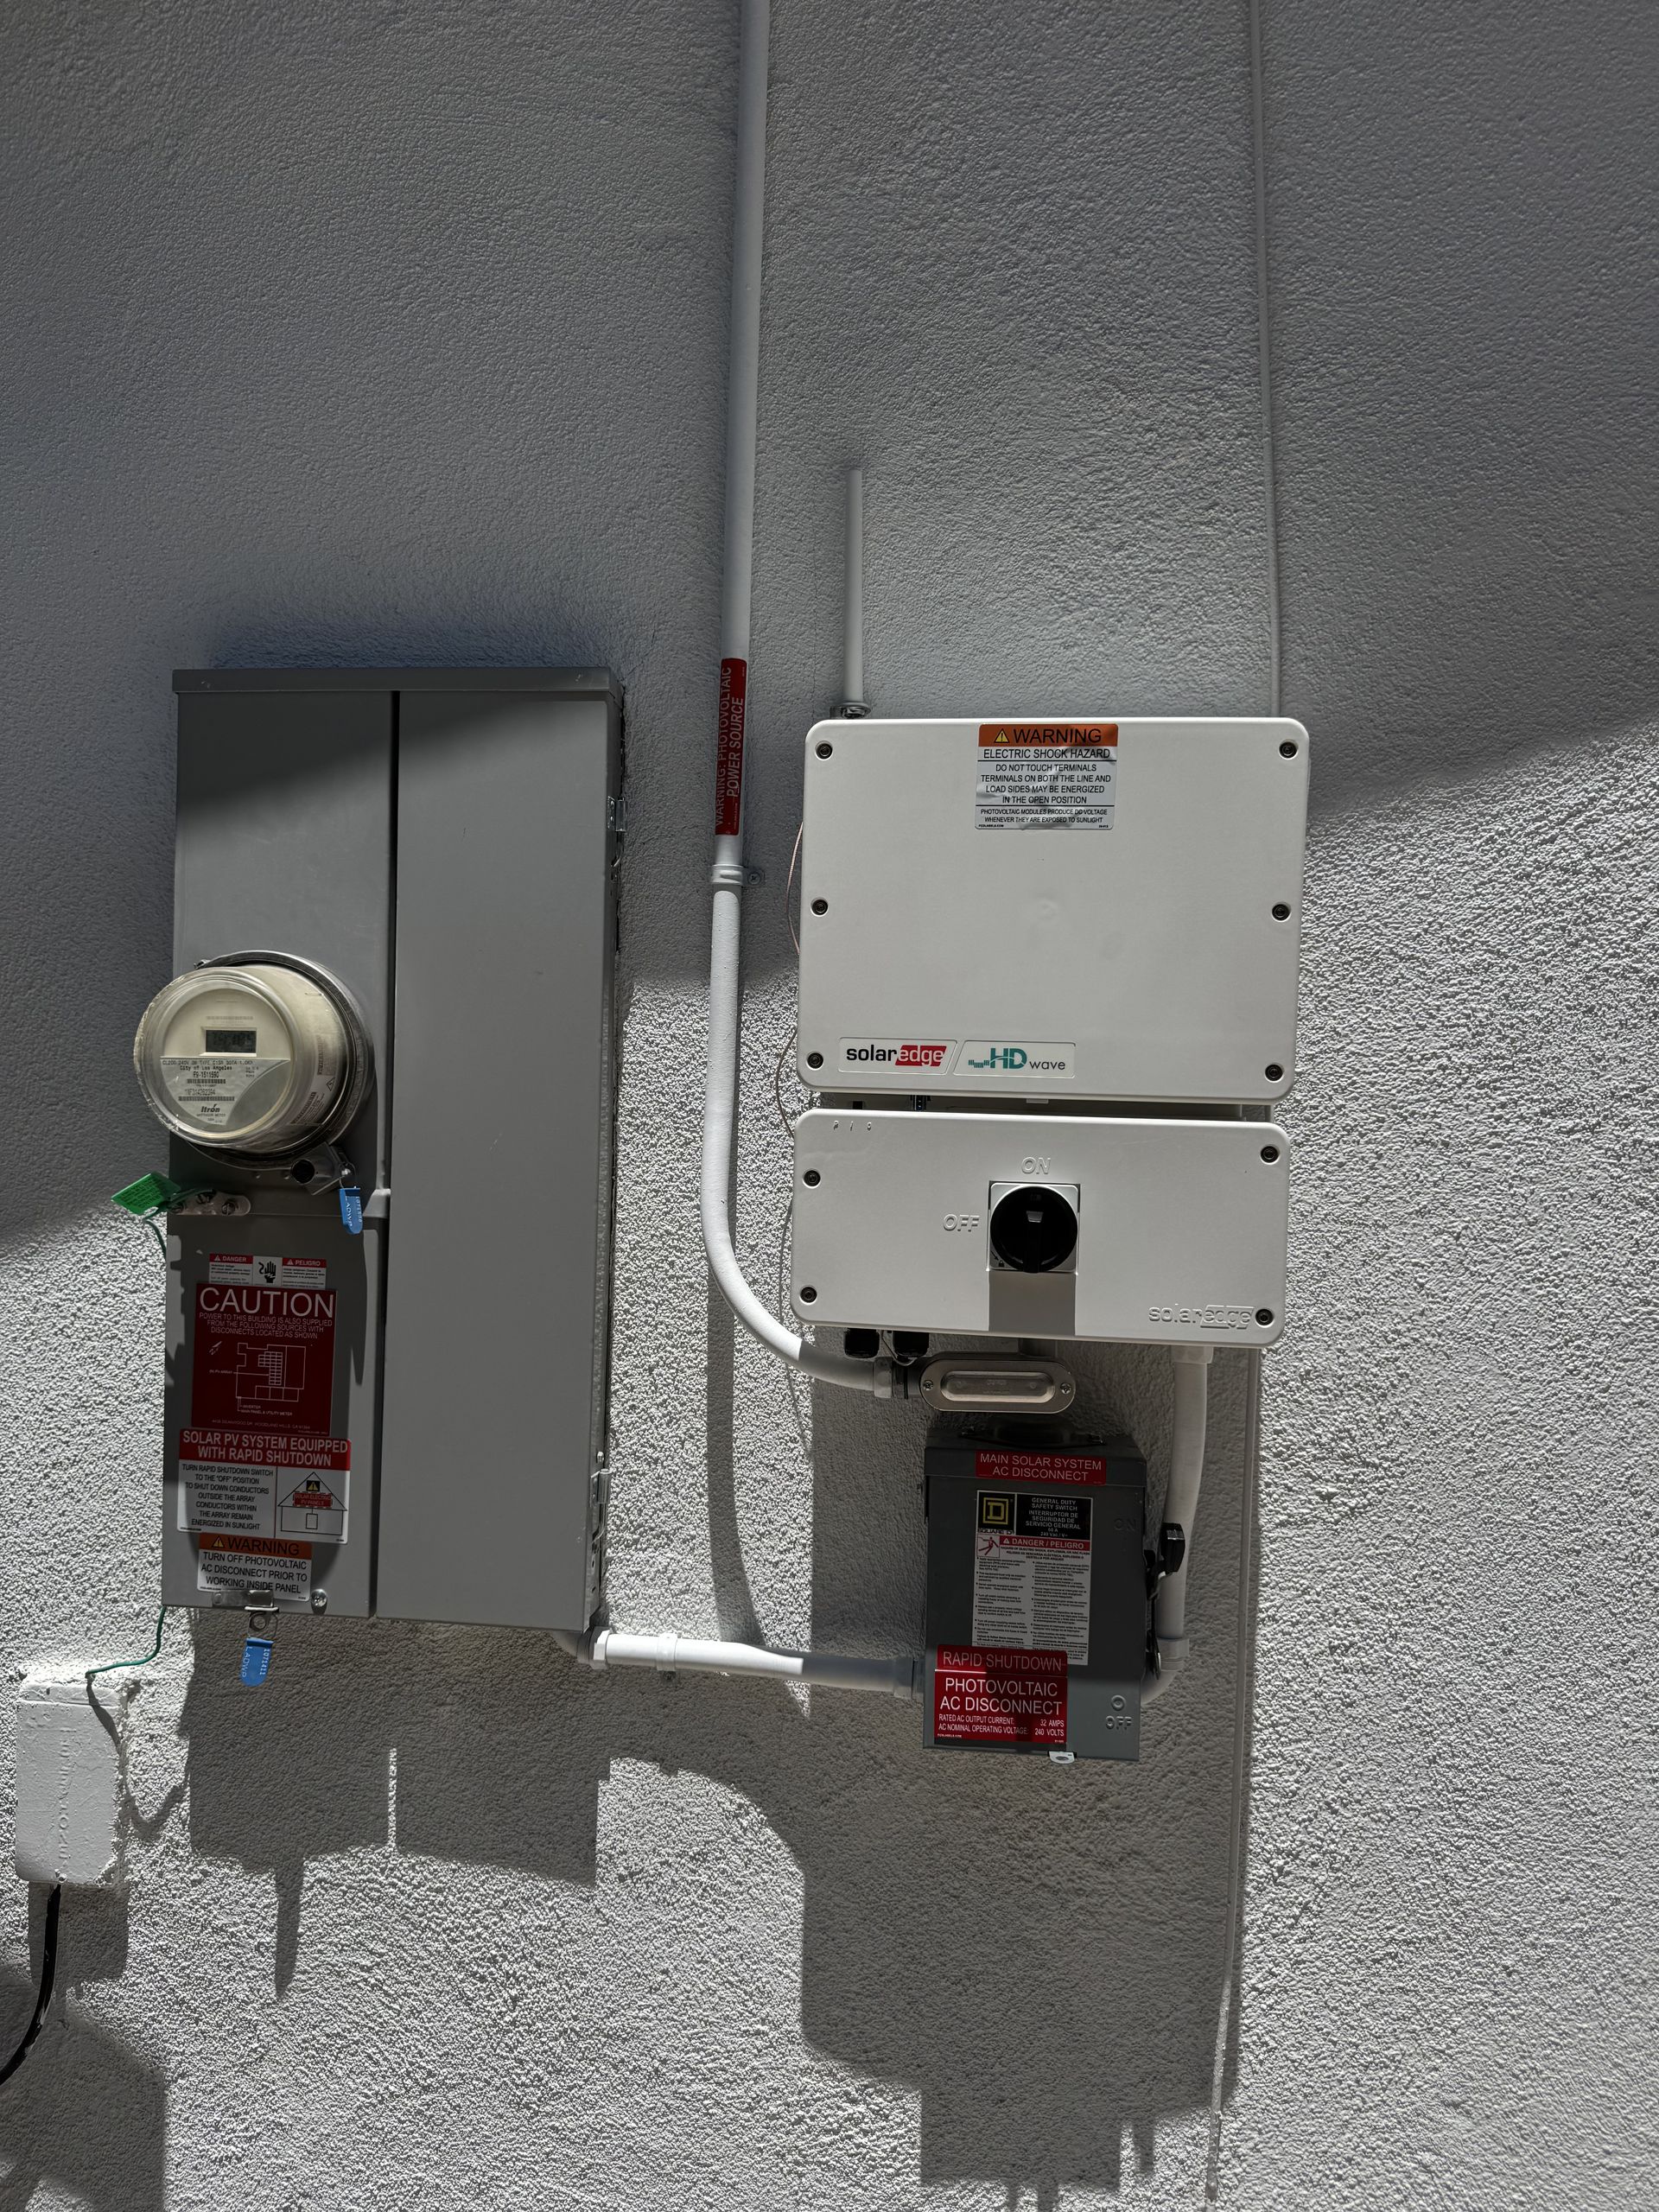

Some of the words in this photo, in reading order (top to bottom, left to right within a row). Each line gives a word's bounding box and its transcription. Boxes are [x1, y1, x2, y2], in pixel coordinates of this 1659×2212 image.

[719, 667, 732, 761] PHOTOVOLTAIC
[729, 697, 743, 748] SOURCE
[1014, 728, 1102, 743] WARNING
[983, 749, 1031, 759] ELECTRIC
[1033, 749, 1068, 759] SHOCK
[1071, 748, 1110, 759] HAZARD
[727, 752, 741, 797] POWER
[716, 764, 727, 827] WARNING:
[846, 1044, 944, 1066] solaredge
[990, 1047, 1027, 1070] HD
[1029, 1059, 1065, 1071] wave
[1021, 1157, 1051, 1175] ON
[943, 1214, 980, 1232] OFF
[200, 1287, 334, 1319] CAUTION
[211, 1326, 254, 1335] DISCONNECTS
[295, 1331, 318, 1339] SHOWN
[239, 1321, 276, 1330] FOLLOWING
[183, 1430, 221, 1445] SOLAR
[224, 1433, 239, 1446] PV
[242, 1433, 287, 1449] SYSTEM
[290, 1437, 348, 1453] EQUIPPED
[198, 1446, 226, 1459] WITH
[229, 1446, 263, 1462] RAPID
[266, 1450, 331, 1466] SHUTDOWN
[980, 1452, 1008, 1465] MAIN
[1011, 1454, 1052, 1467] SOLAR
[1054, 1457, 1102, 1471] SYSTEM
[217, 1465, 250, 1475] SHUTDOWN
[992, 1465, 1011, 1477] AC
[1014, 1467, 1089, 1482] DISCONNECT
[229, 1484, 269, 1494] CONDUCTORS
[196, 1501, 236, 1510] CONDUCTORS
[1028, 1510, 1069, 1518] INTERRUPTOR
[191, 1518, 224, 1527] ENERGIZED
[232, 1522, 260, 1530] SUNLIGHT
[228, 1537, 299, 1556] WARNING
[1051, 1541, 1084, 1549] PELIGRO
[203, 1551, 225, 1561] TURN
[226, 1554, 244, 1563] OFF
[245, 1554, 307, 1570] PHOTOVOLTAIC
[201, 1563, 213, 1573] AC
[215, 1565, 266, 1578] DISCONNECT
[269, 1569, 294, 1580] PRIOR
[296, 1573, 308, 1582] TO
[206, 1575, 245, 1588] WORKING
[246, 1580, 273, 1591] INSIDE
[275, 1583, 302, 1594] PANEL
[242, 1646, 253, 1678] LADWP
[943, 1650, 982, 1668] RAPID
[986, 1654, 1062, 1672] SHUTDOWN
[944, 1676, 1058, 1698] PHOTOVOLTAIC
[939, 1695, 962, 1711] AC
[965, 1696, 1063, 1716] DISCONNECT
[938, 1713, 957, 1722] RATED
[965, 1715, 987, 1724] OUTPUT
[1105, 1715, 1132, 1730] OFF
[947, 1724, 970, 1732] NOMINAL
[971, 1725, 1002, 1734] OPERATING
[1046, 1728, 1065, 1737] VOLTS
